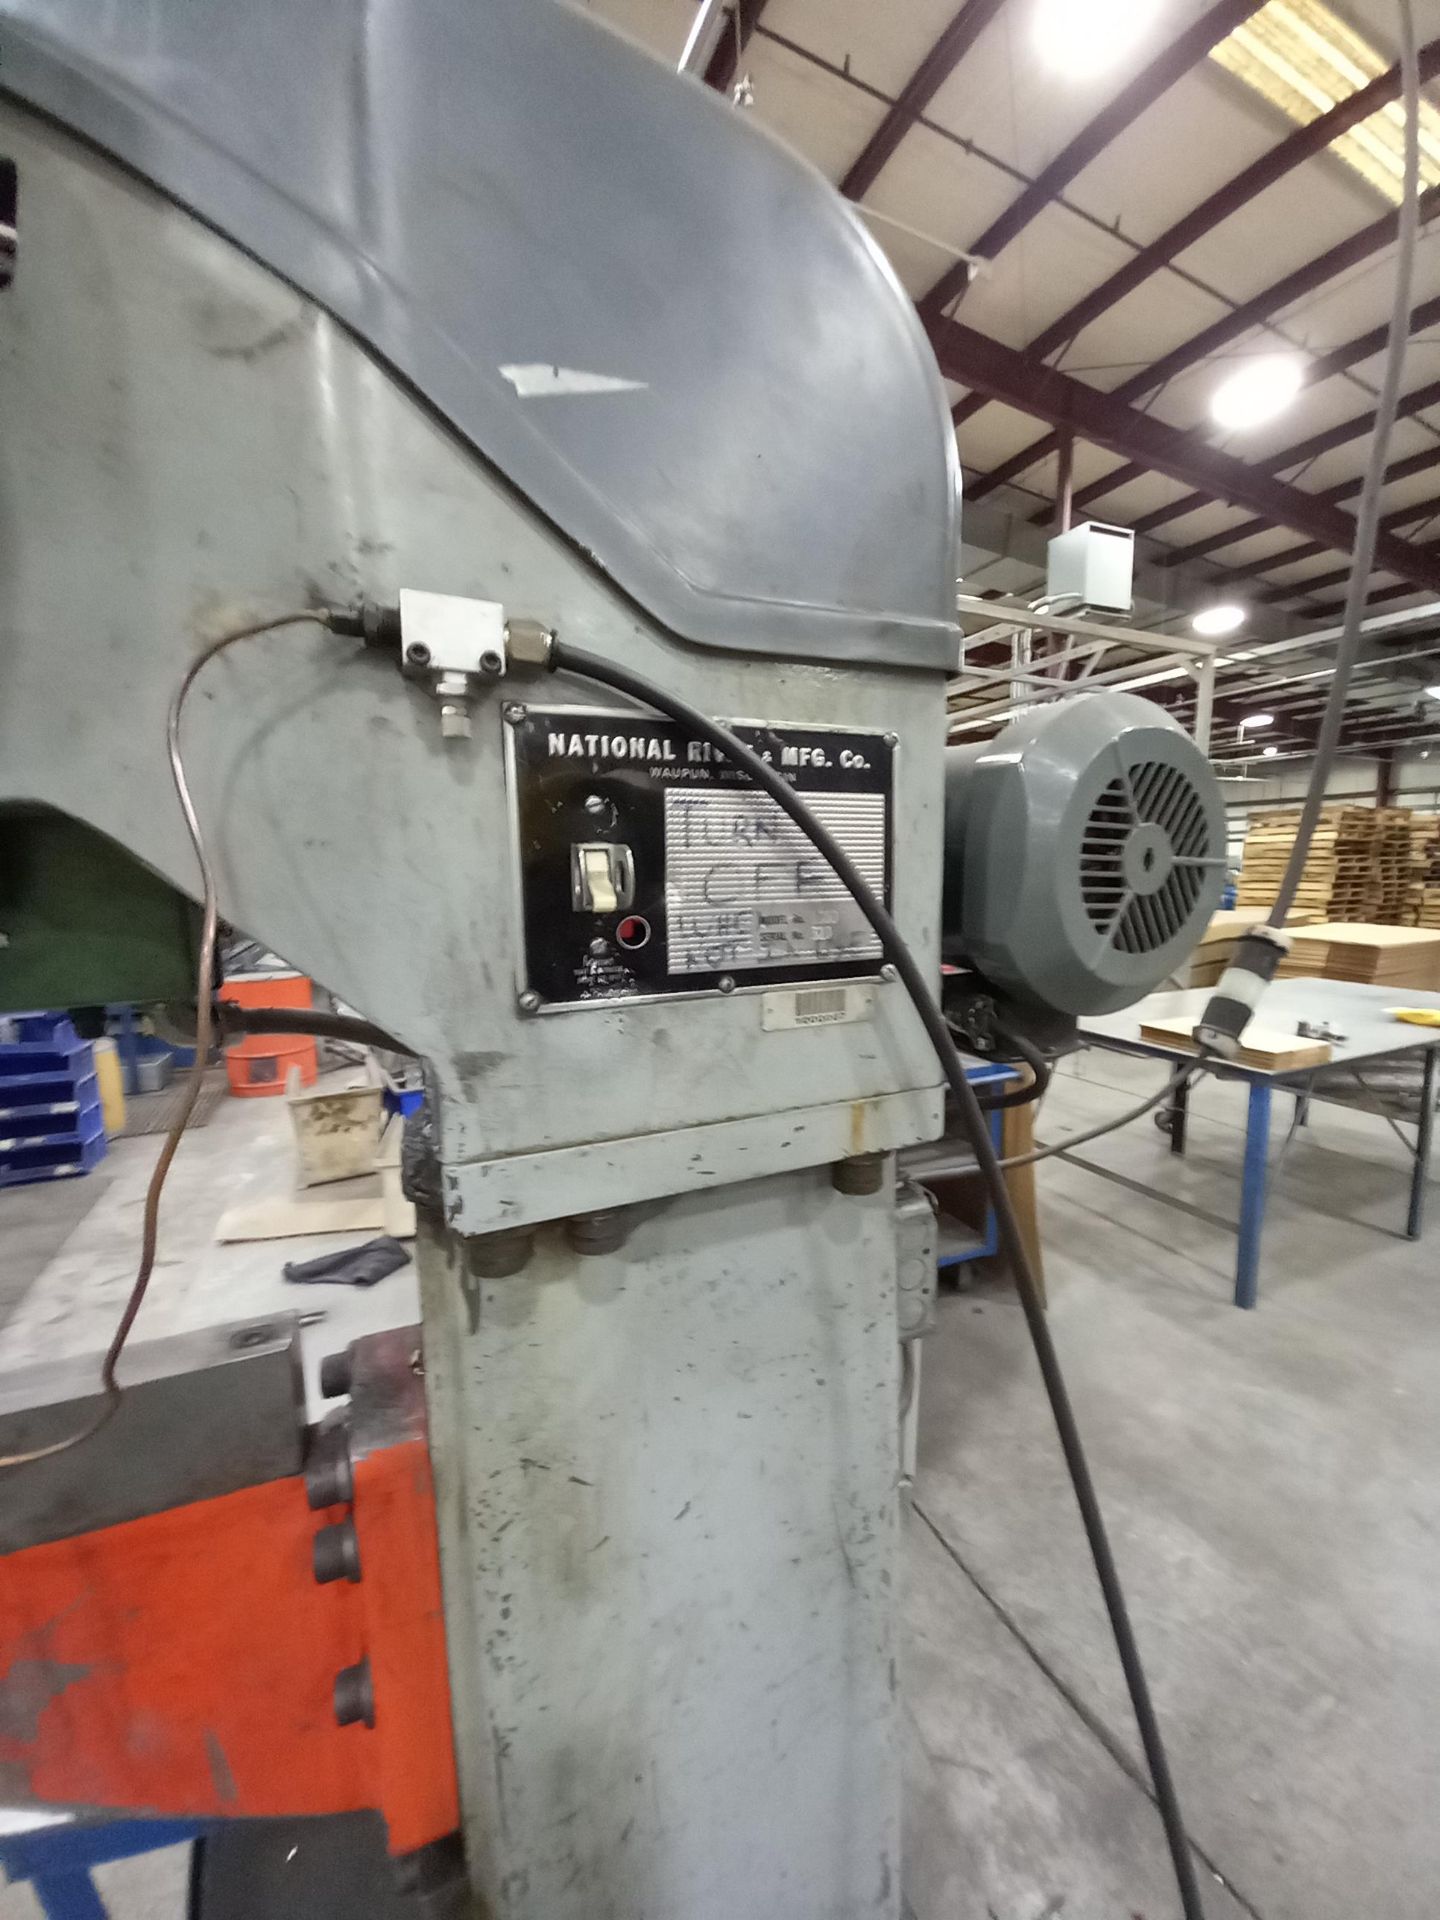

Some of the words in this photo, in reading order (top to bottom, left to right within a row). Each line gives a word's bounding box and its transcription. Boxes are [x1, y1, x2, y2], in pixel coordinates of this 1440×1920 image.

[547, 732, 677, 761] NATIONAL
[780, 746, 833, 768] MFG.
[839, 749, 871, 770] Co.
